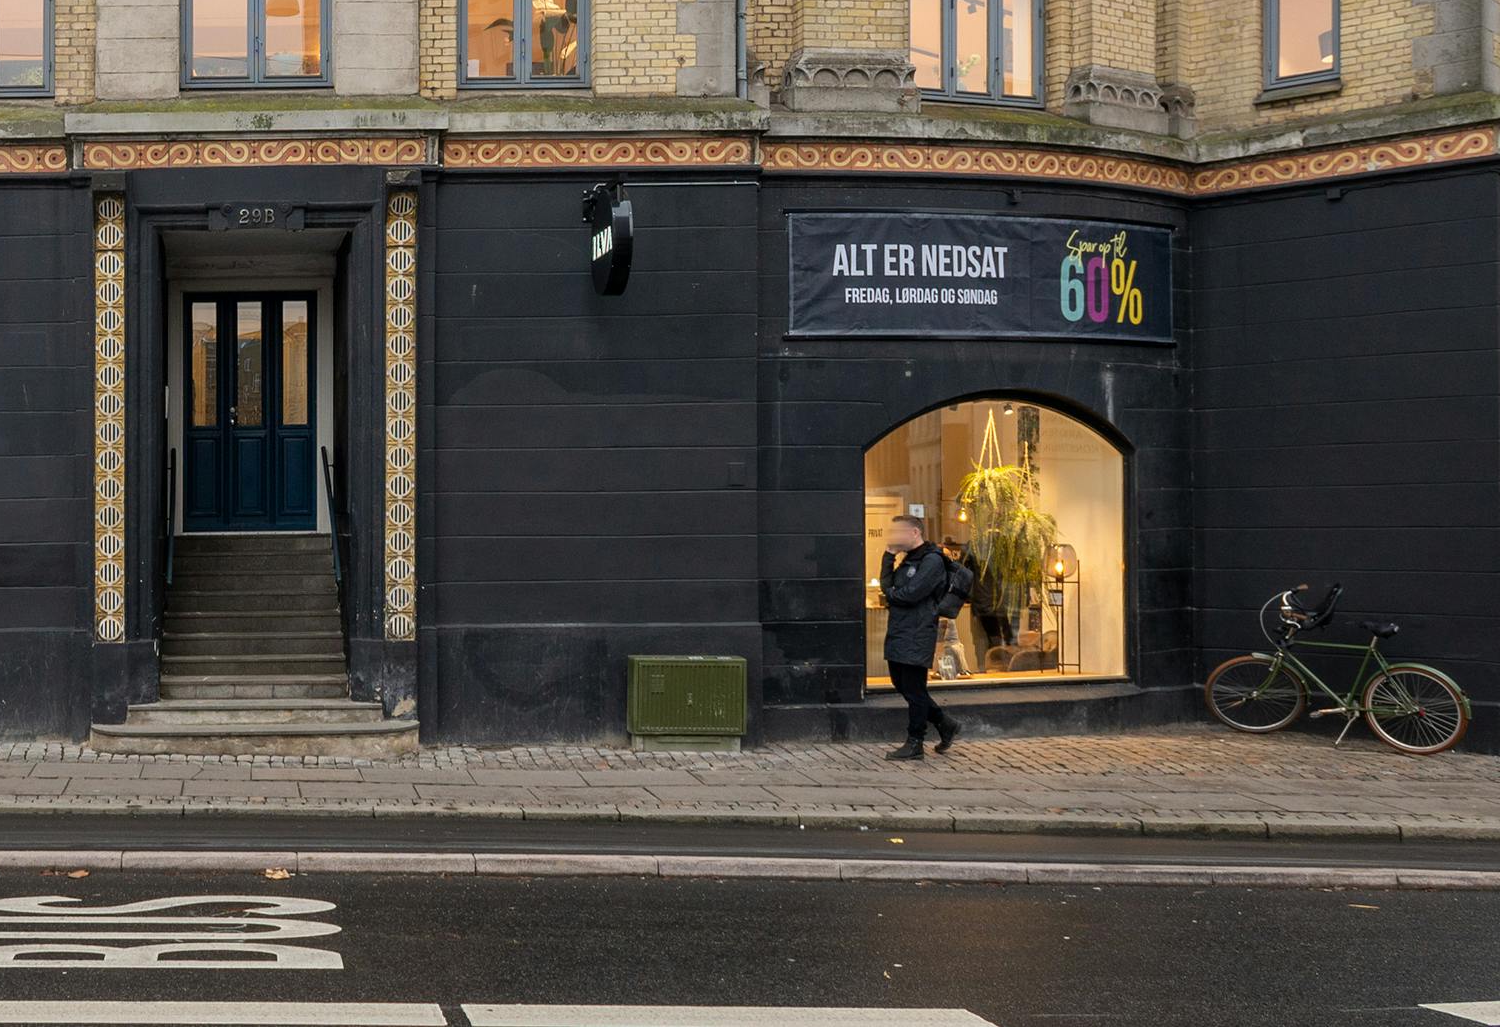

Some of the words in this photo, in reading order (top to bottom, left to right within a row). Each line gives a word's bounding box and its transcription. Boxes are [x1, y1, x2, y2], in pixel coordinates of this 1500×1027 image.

[238, 208, 275, 224] 29B
[592, 225, 613, 261] ILVA
[832, 243, 878, 277] ALT
[883, 243, 915, 277] ER
[921, 244, 1008, 279] NEDSAT
[1066, 229, 1098, 268] Spar
[1099, 242, 1111, 269] op
[1110, 230, 1128, 259] til
[845, 287, 893, 305] FREDAG,
[895, 287, 939, 304] LØRDAG
[940, 288, 956, 304] OG
[957, 289, 998, 305] SØNDAG
[1061, 256, 1143, 325] 60%
